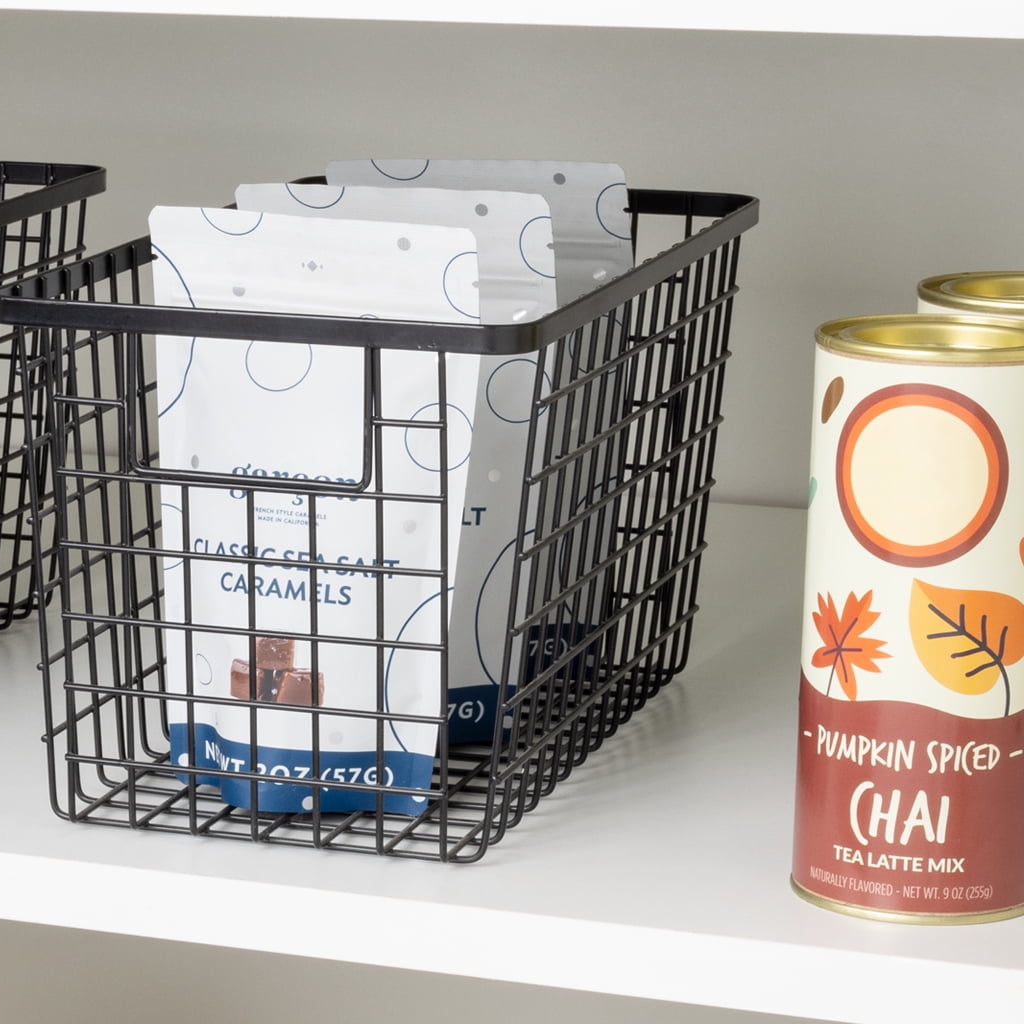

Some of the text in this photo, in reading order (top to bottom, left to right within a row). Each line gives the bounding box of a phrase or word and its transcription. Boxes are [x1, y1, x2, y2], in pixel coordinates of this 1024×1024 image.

[220, 572, 353, 606] CARAMELS
[817, 724, 1001, 776] PUMPKIN SPICED
[320, 766, 394, 792] (57G)
[849, 781, 950, 846] CHAI
[833, 844, 966, 874] TEA LATTE MIX
[810, 865, 848, 887] NATURALLY
[848, 876, 894, 896] FLAVORED
[903, 885, 922, 899] NET
[923, 886, 941, 900] WT.
[942, 886, 950, 900] 9
[951, 886, 964, 900] OZ
[965, 884, 994, 902] (255g)
